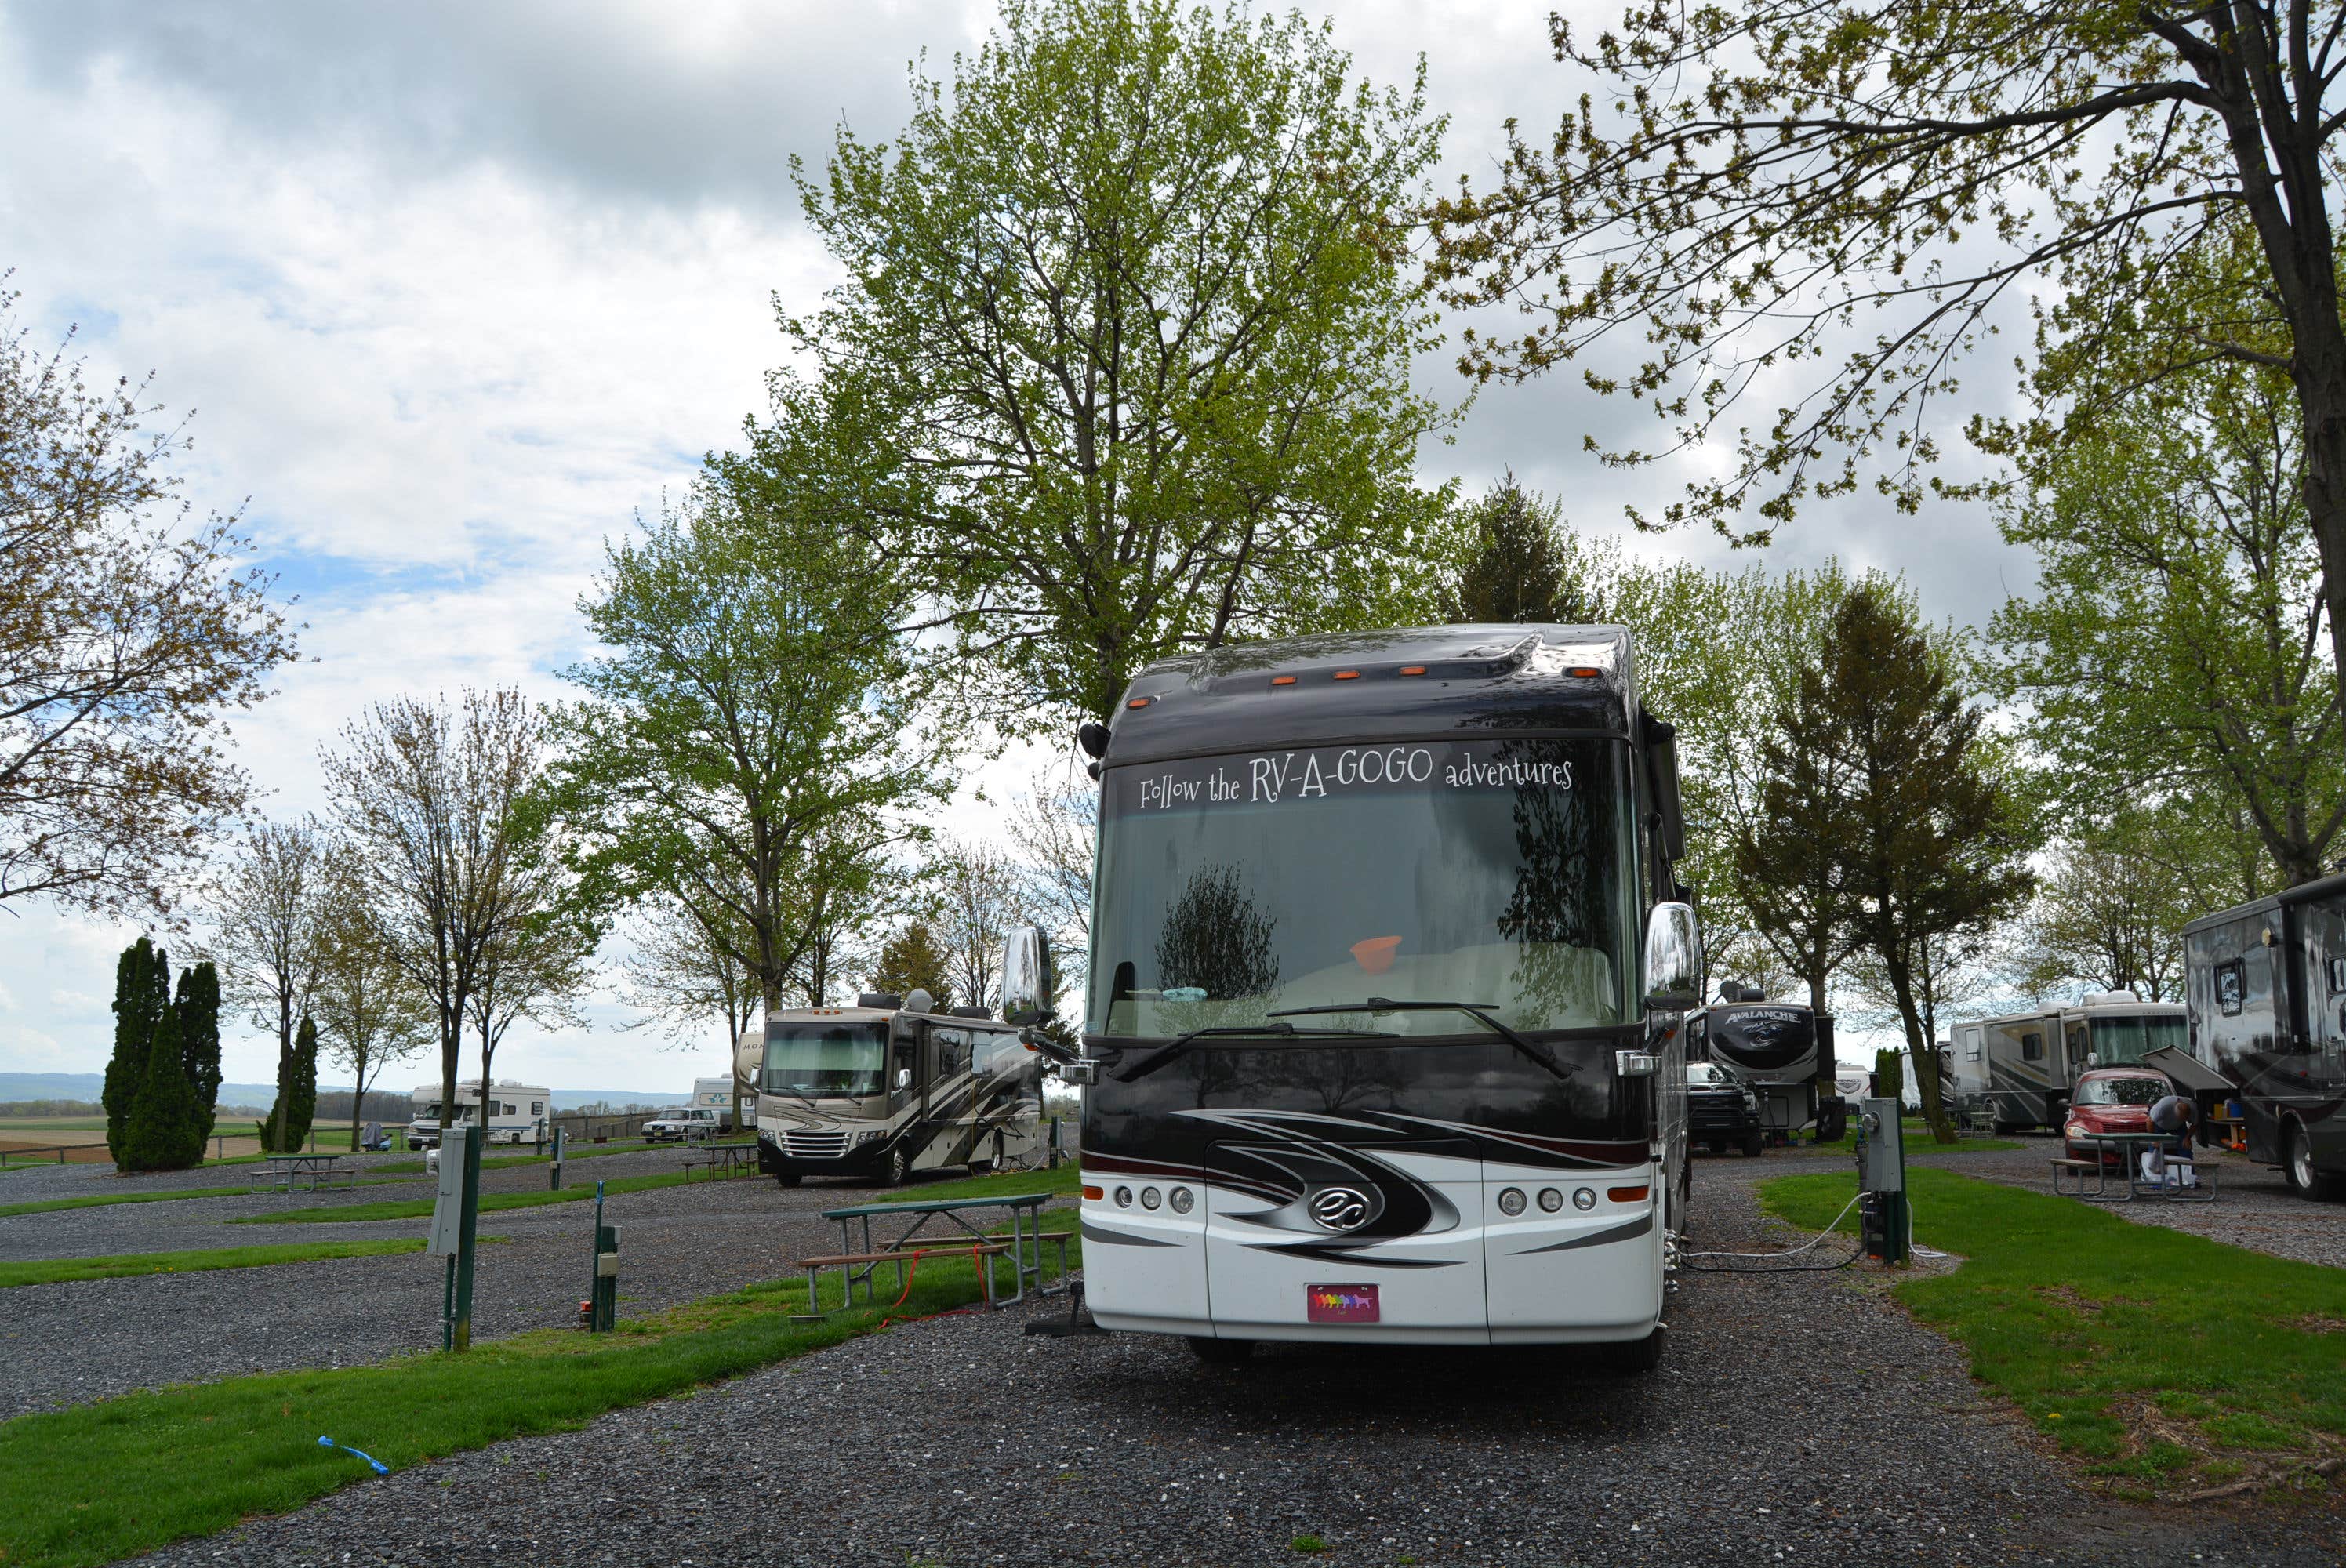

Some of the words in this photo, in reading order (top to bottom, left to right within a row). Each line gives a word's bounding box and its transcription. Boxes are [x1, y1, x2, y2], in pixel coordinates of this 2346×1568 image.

[1141, 775, 1202, 809] Follow
[1209, 767, 1240, 802] the
[1249, 747, 1433, 804] RV-A-GOGO
[1445, 753, 1573, 789] adventures
[1725, 1011, 1802, 1025] AVALANCHE
